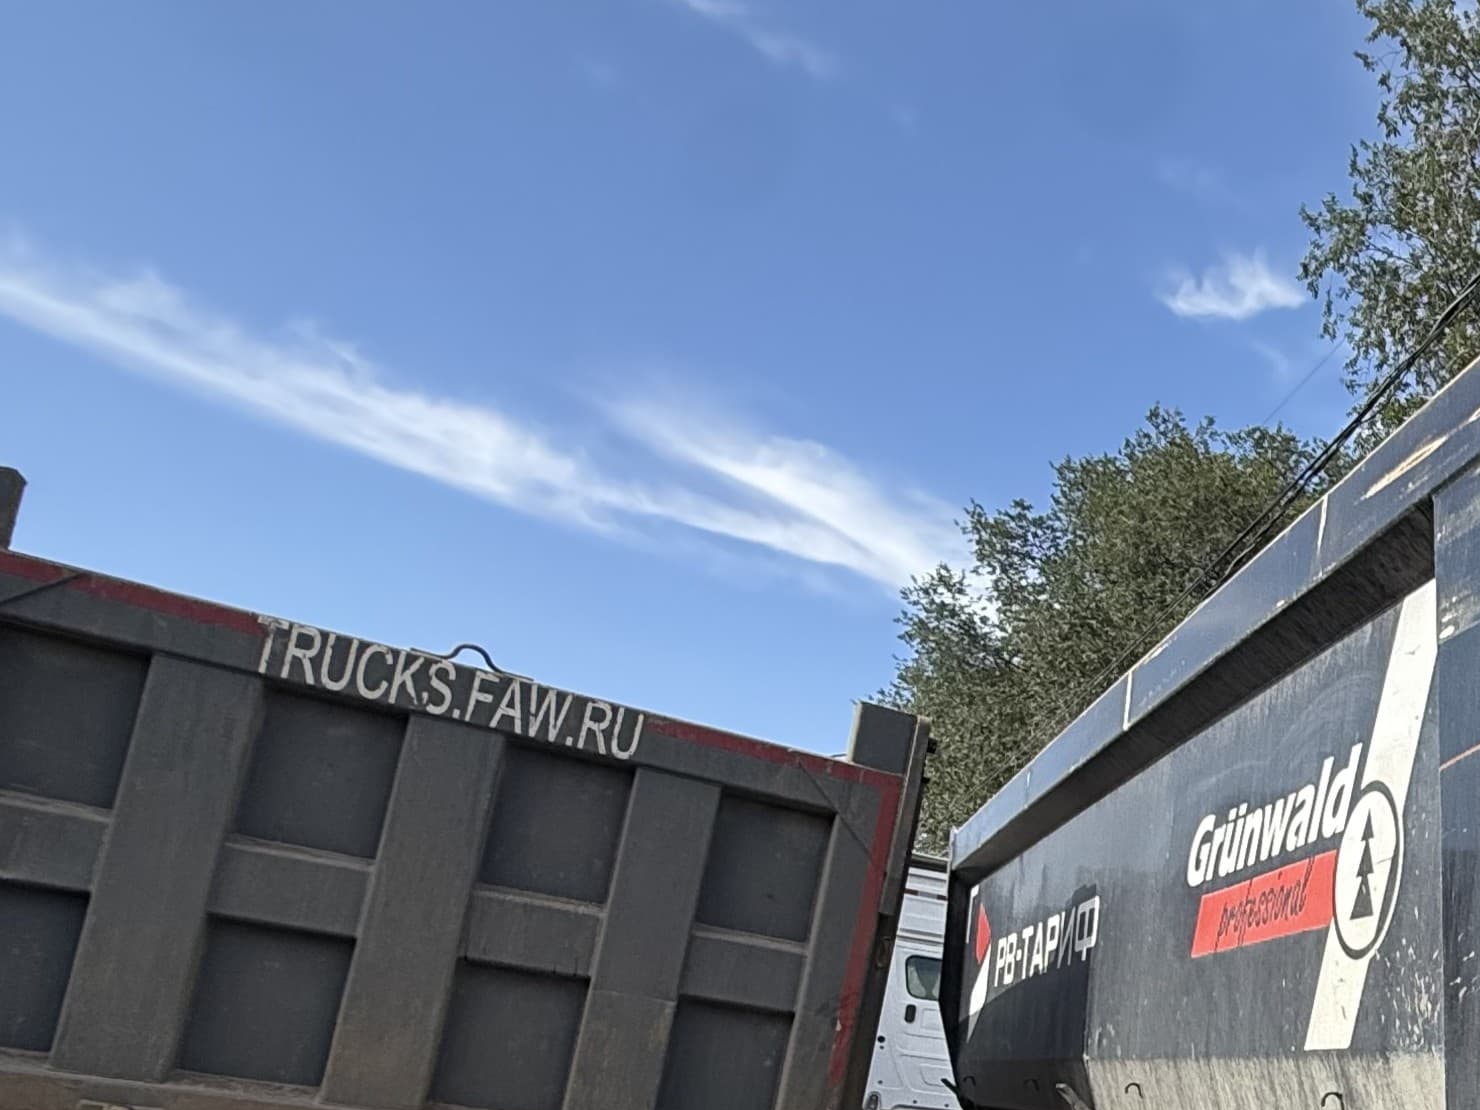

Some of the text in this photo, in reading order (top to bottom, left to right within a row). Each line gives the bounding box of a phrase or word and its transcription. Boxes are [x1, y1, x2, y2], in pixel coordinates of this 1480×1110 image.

[259, 614, 643, 759] TRUCKS.FAW.RU
[1187, 742, 1363, 887] Grünwald
[1214, 857, 1316, 954] professional
